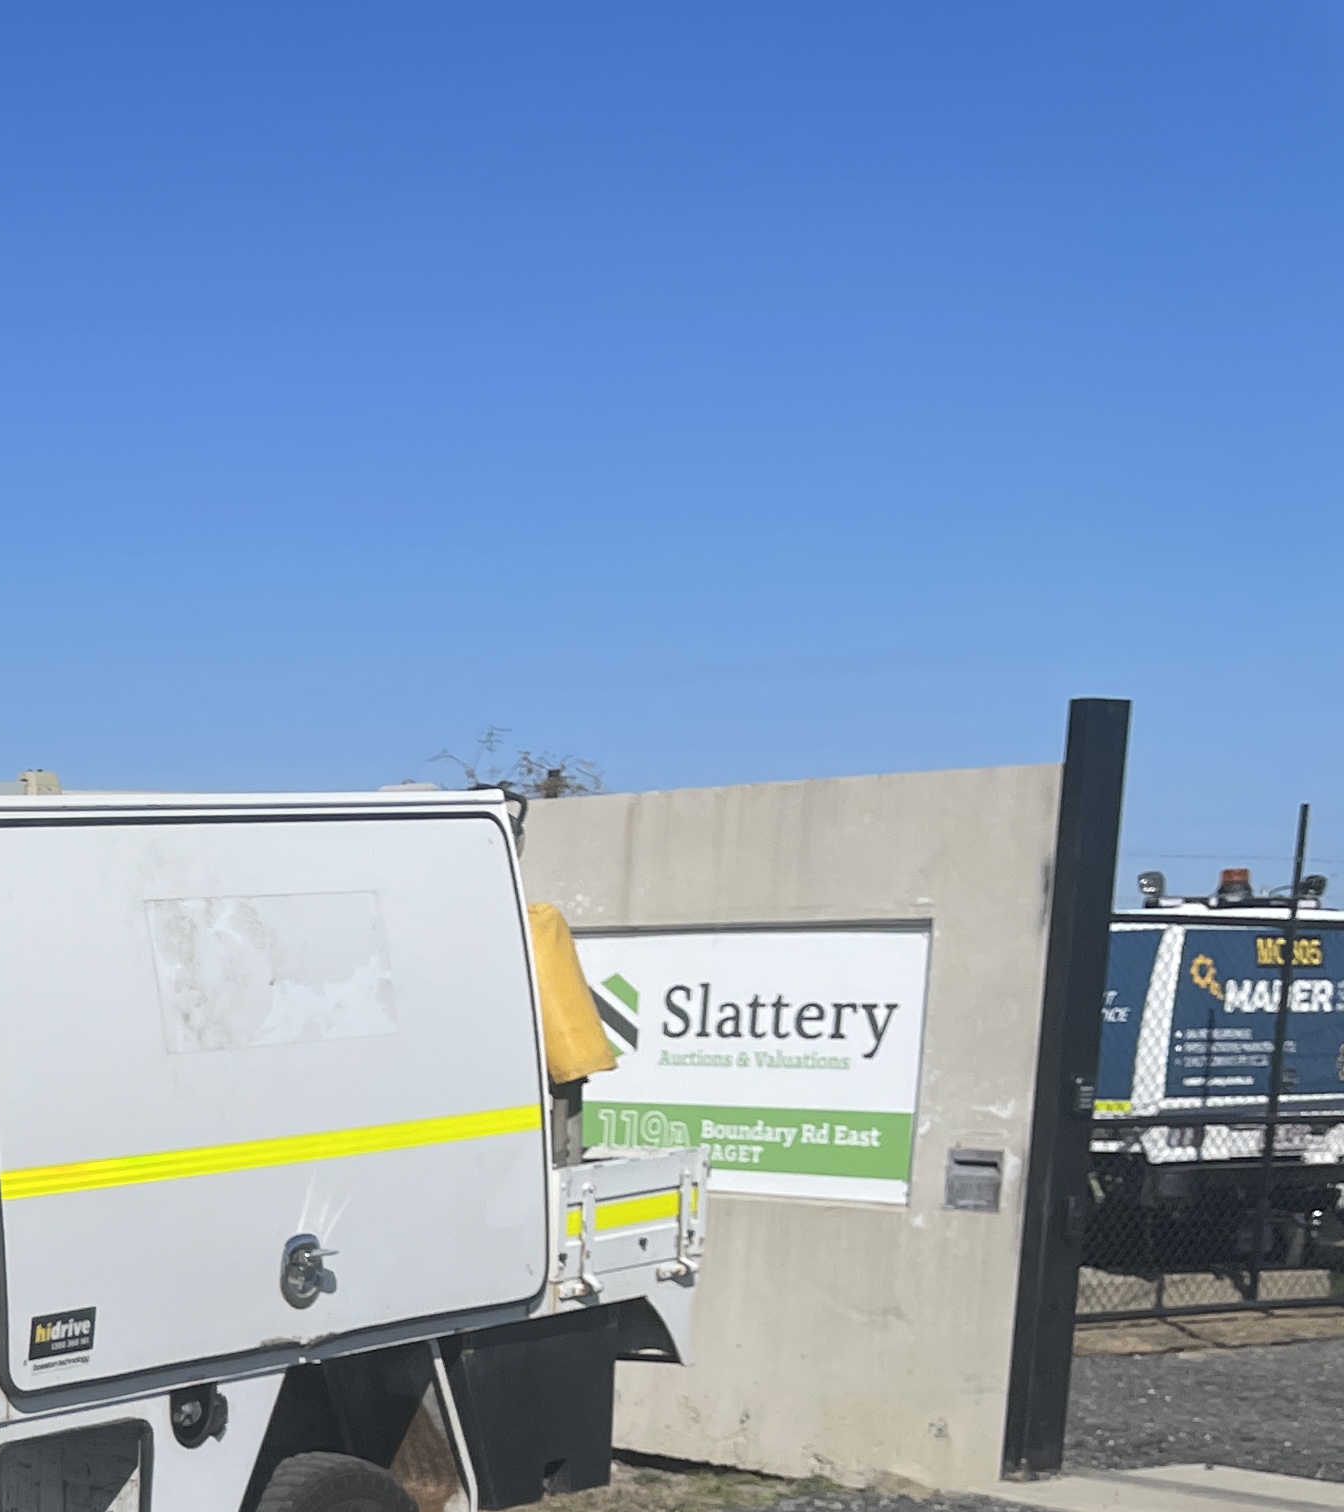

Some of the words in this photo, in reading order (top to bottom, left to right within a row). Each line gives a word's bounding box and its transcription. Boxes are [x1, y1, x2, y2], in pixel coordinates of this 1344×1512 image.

[662, 982, 898, 1059] Slattery
[659, 1050, 733, 1067] Auctions
[736, 1051, 751, 1067] &
[755, 1050, 851, 1070] Valuations
[701, 1119, 798, 1148] Boundary
[801, 1122, 830, 1145] Rd
[834, 1126, 882, 1148] East
[701, 1142, 764, 1164] PAGET
[34, 1318, 91, 1344] hidrive
